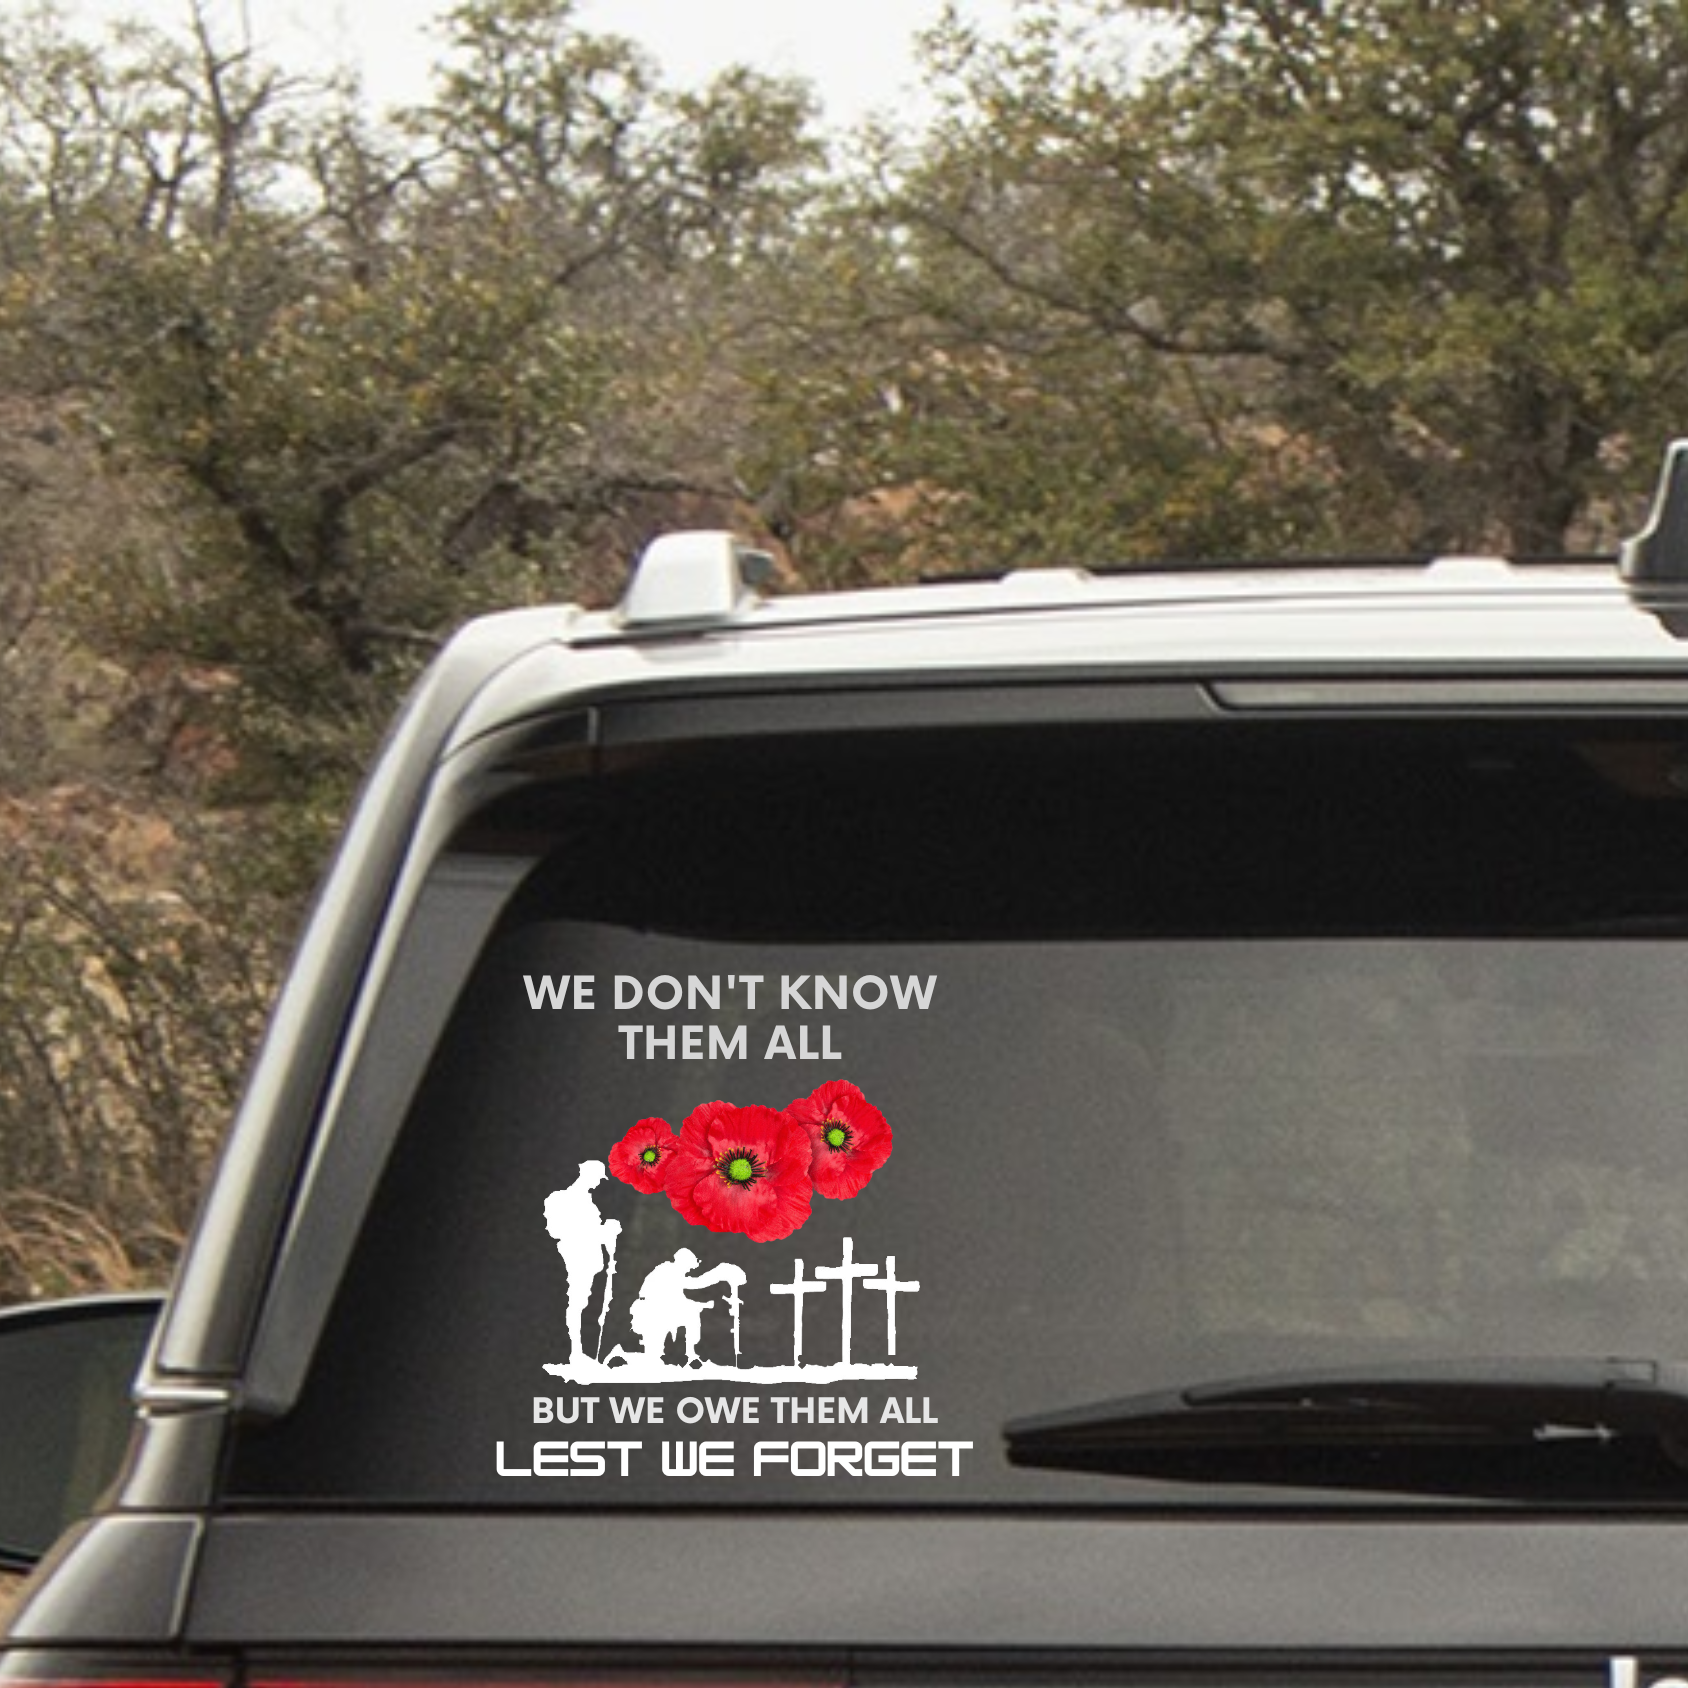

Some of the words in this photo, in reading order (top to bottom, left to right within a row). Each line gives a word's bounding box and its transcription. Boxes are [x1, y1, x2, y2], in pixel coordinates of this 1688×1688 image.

[523, 975, 595, 1010] WE
[614, 974, 765, 1010] DON'T
[781, 974, 938, 1010] KNOW
[618, 1024, 747, 1060] THEM
[763, 1024, 842, 1060] ALL
[533, 1396, 600, 1424] BUT
[609, 1396, 664, 1424] WE
[676, 1396, 760, 1424] OWE
[770, 1396, 868, 1424] THEM
[879, 1396, 939, 1424] ALL
[496, 1440, 643, 1477] LEST
[661, 1440, 735, 1477] WE
[753, 1440, 974, 1477] FORGET
